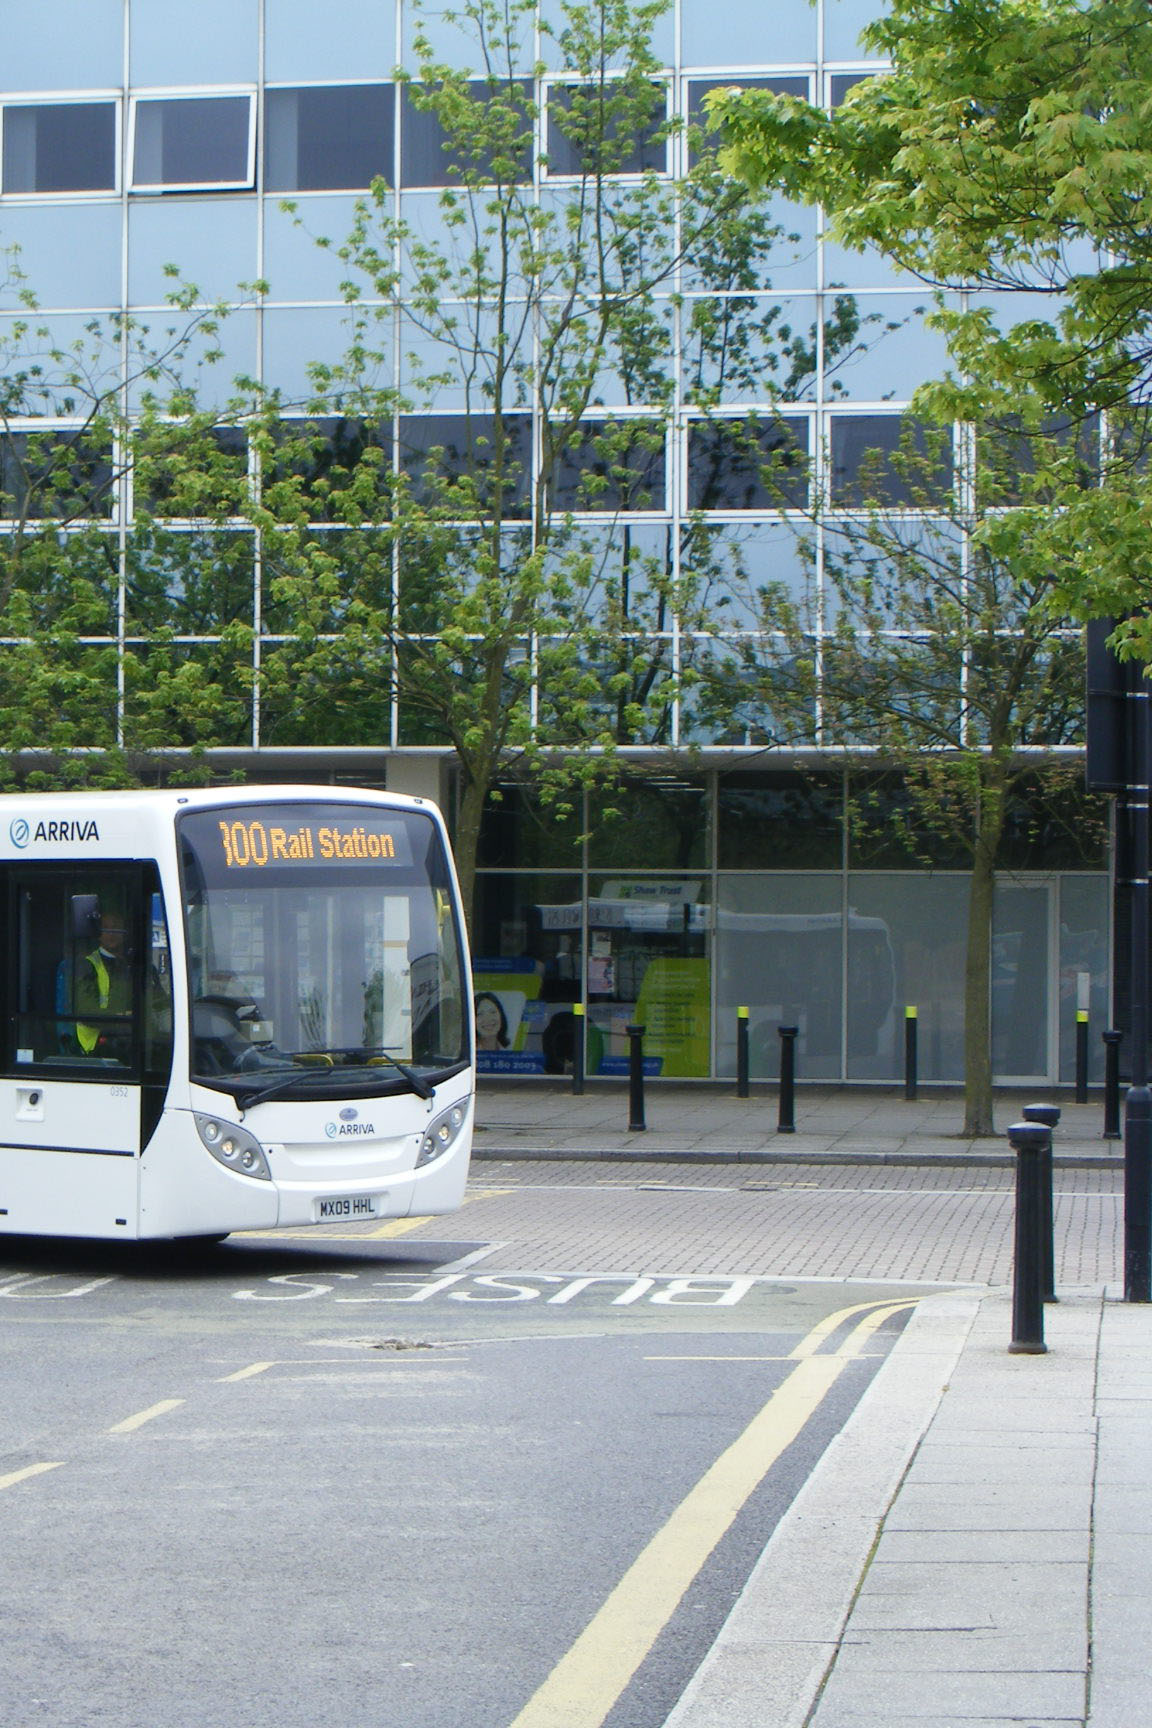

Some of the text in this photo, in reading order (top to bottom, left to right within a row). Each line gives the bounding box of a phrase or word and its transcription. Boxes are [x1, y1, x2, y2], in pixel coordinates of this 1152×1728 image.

[33, 821, 100, 842] ARRIVA
[270, 828, 314, 859] Rail
[317, 827, 395, 858] Station
[110, 1085, 128, 1097] 0352
[338, 1123, 375, 1136] ARRIVA
[320, 1198, 375, 1217] MX09 HHL
[231, 1272, 756, 1306] BUSES
